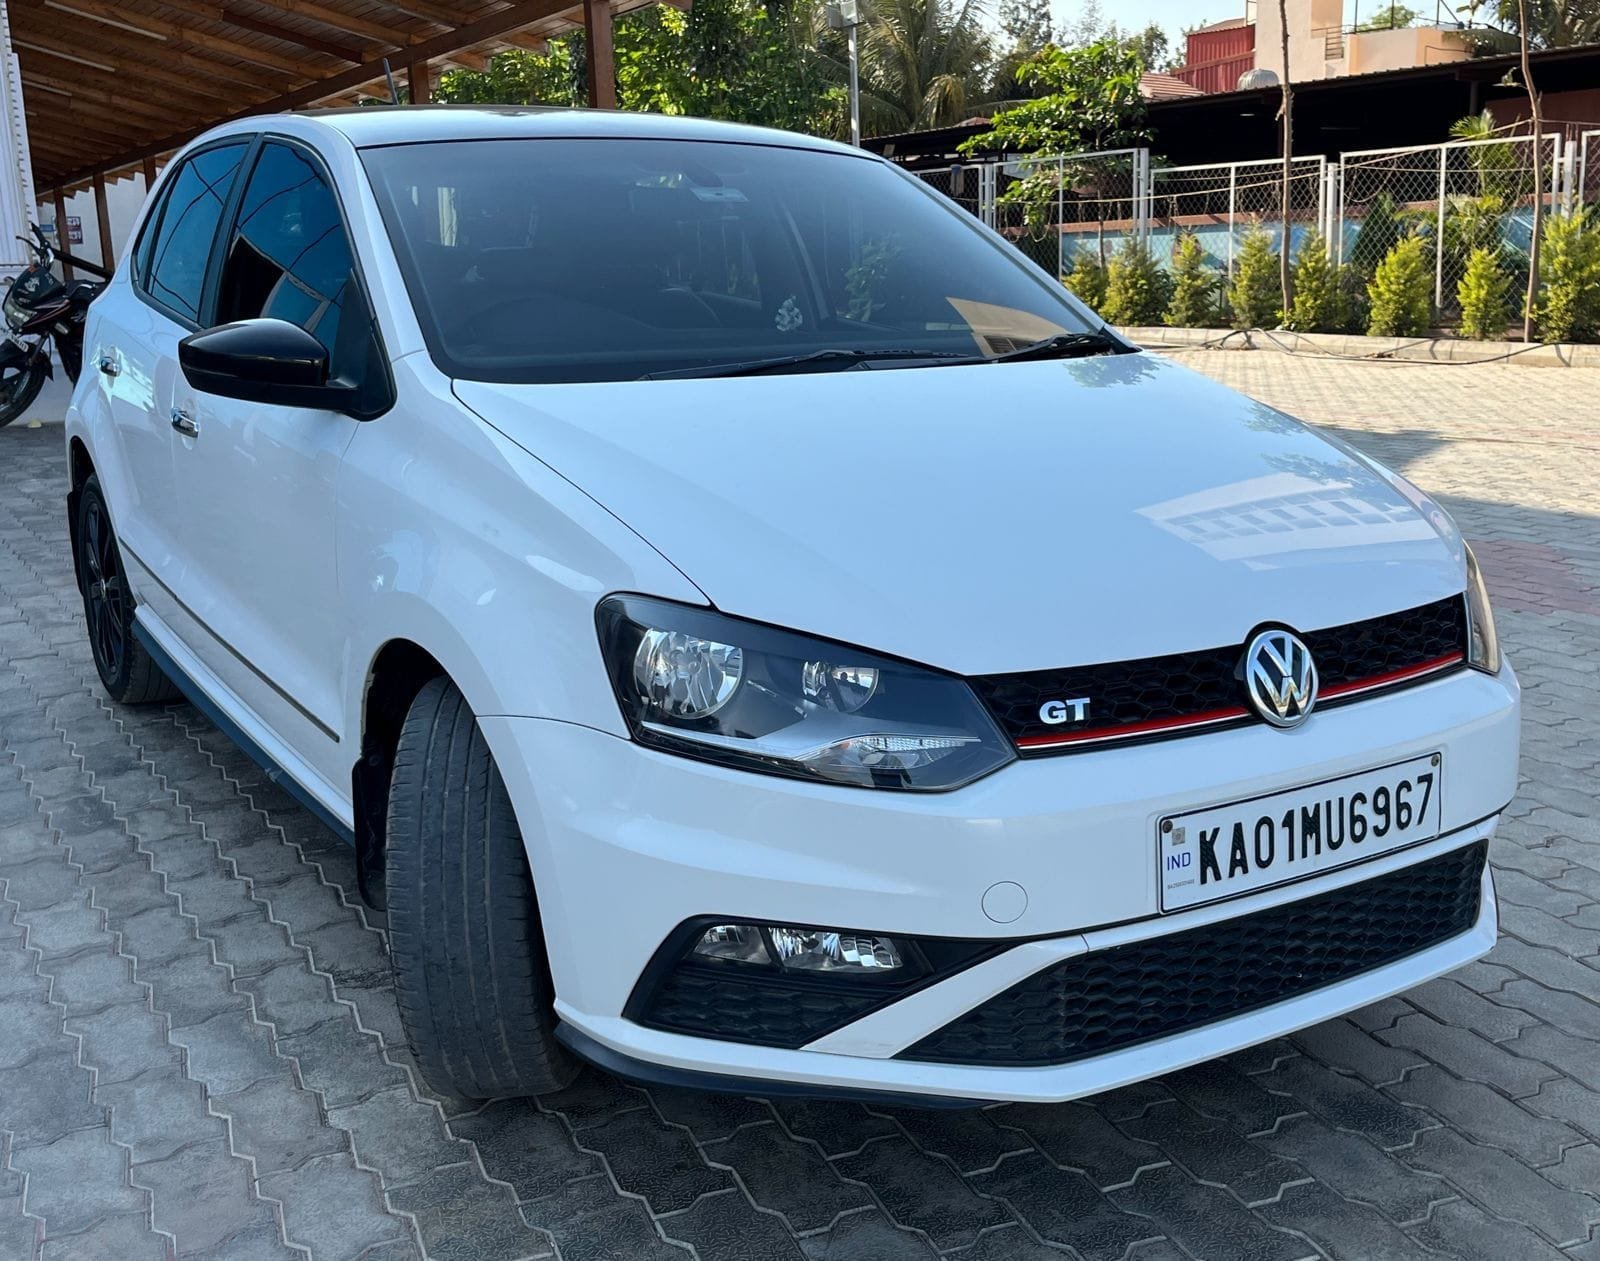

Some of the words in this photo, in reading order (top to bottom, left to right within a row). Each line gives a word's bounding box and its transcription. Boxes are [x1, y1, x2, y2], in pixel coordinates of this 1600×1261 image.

[1039, 697, 1091, 724] GT
[1199, 772, 1433, 885] KA01MU6967
[1167, 851, 1191, 871] IND
